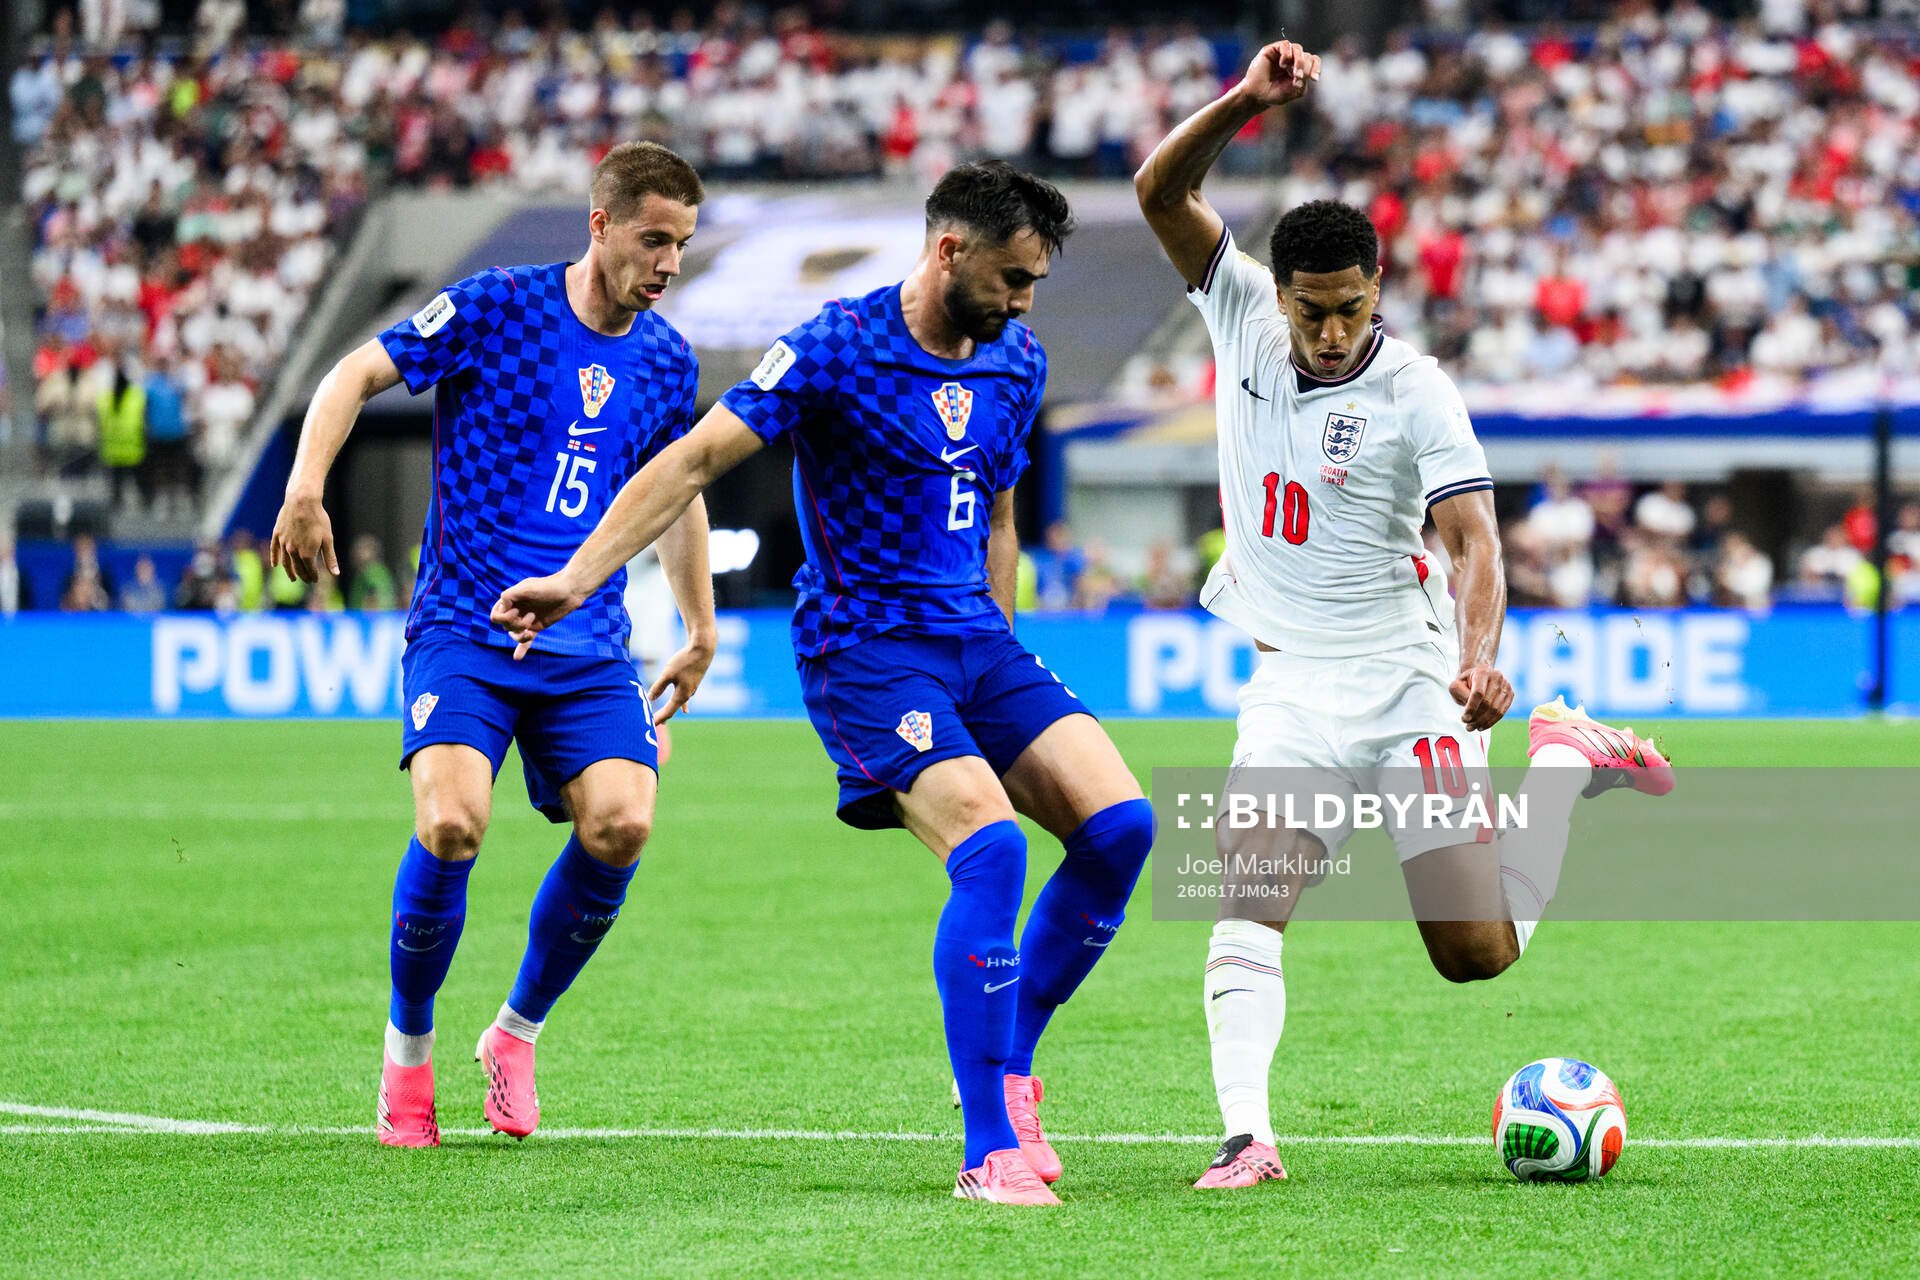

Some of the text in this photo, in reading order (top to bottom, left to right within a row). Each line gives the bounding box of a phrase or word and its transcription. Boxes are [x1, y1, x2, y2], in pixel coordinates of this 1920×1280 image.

[545, 451, 597, 518] 15
[947, 471, 977, 531] 6
[1319, 465, 1348, 478] CROATIA
[1262, 471, 1310, 546] 10
[1413, 735, 1470, 798] 10
